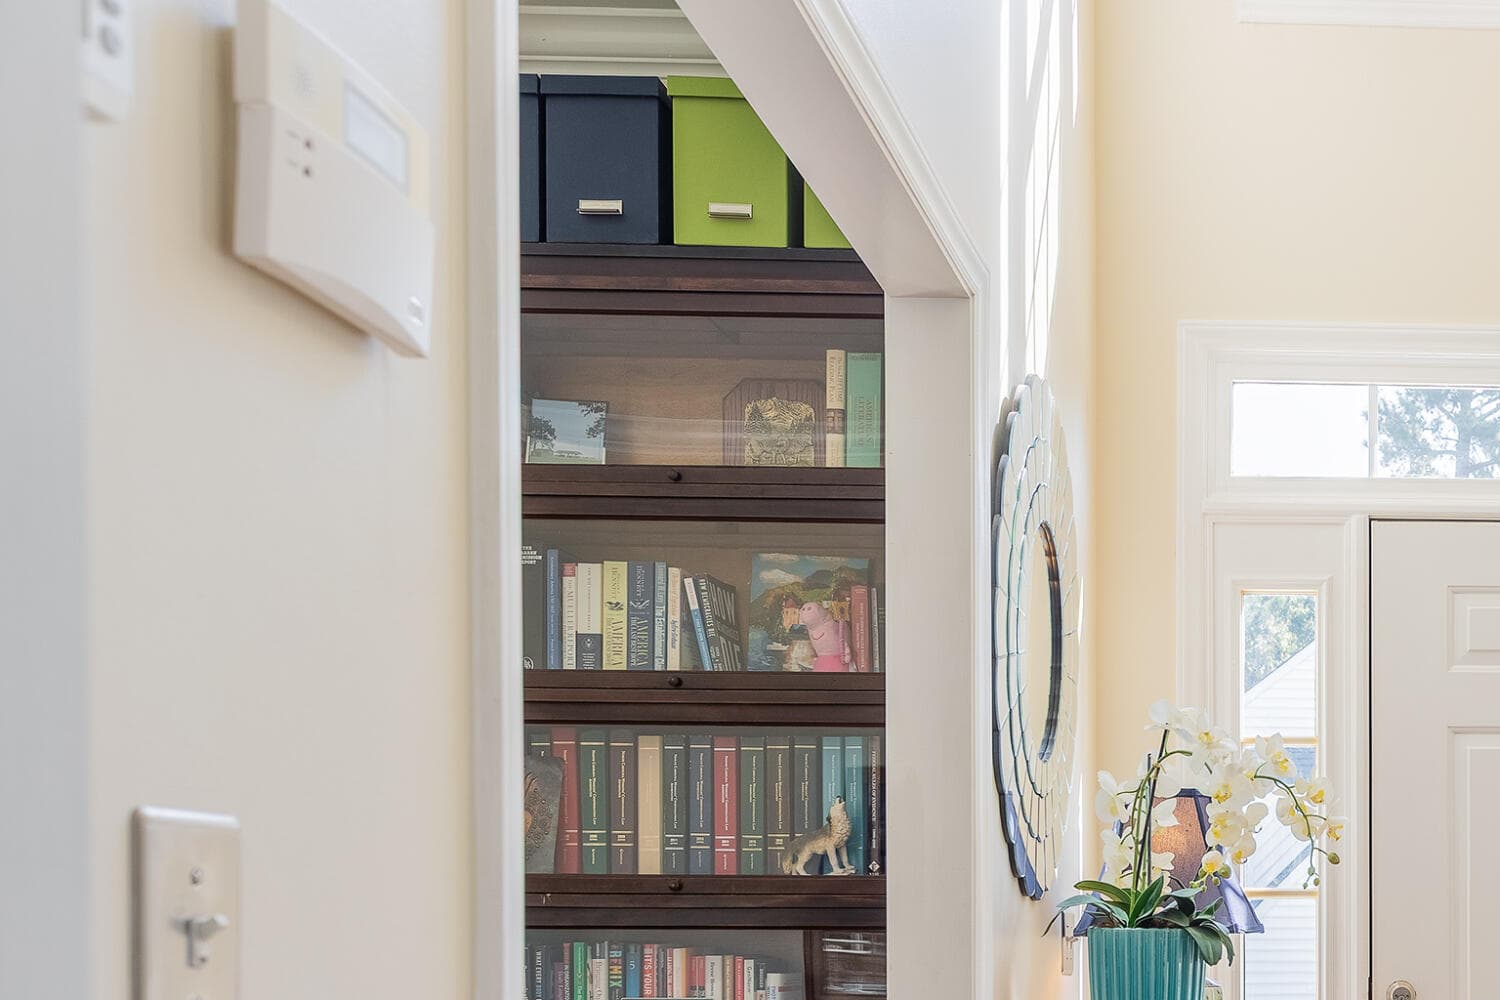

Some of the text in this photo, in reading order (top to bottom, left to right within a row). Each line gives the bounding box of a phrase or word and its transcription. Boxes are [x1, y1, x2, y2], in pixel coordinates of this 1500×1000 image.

[701, 591, 714, 627] DEMOCRACIES
[611, 617, 623, 666] AMERICA
[637, 617, 648, 666] AMERICA
[656, 618, 664, 657] Establishment
[644, 955, 652, 995] IT'S YOUR
